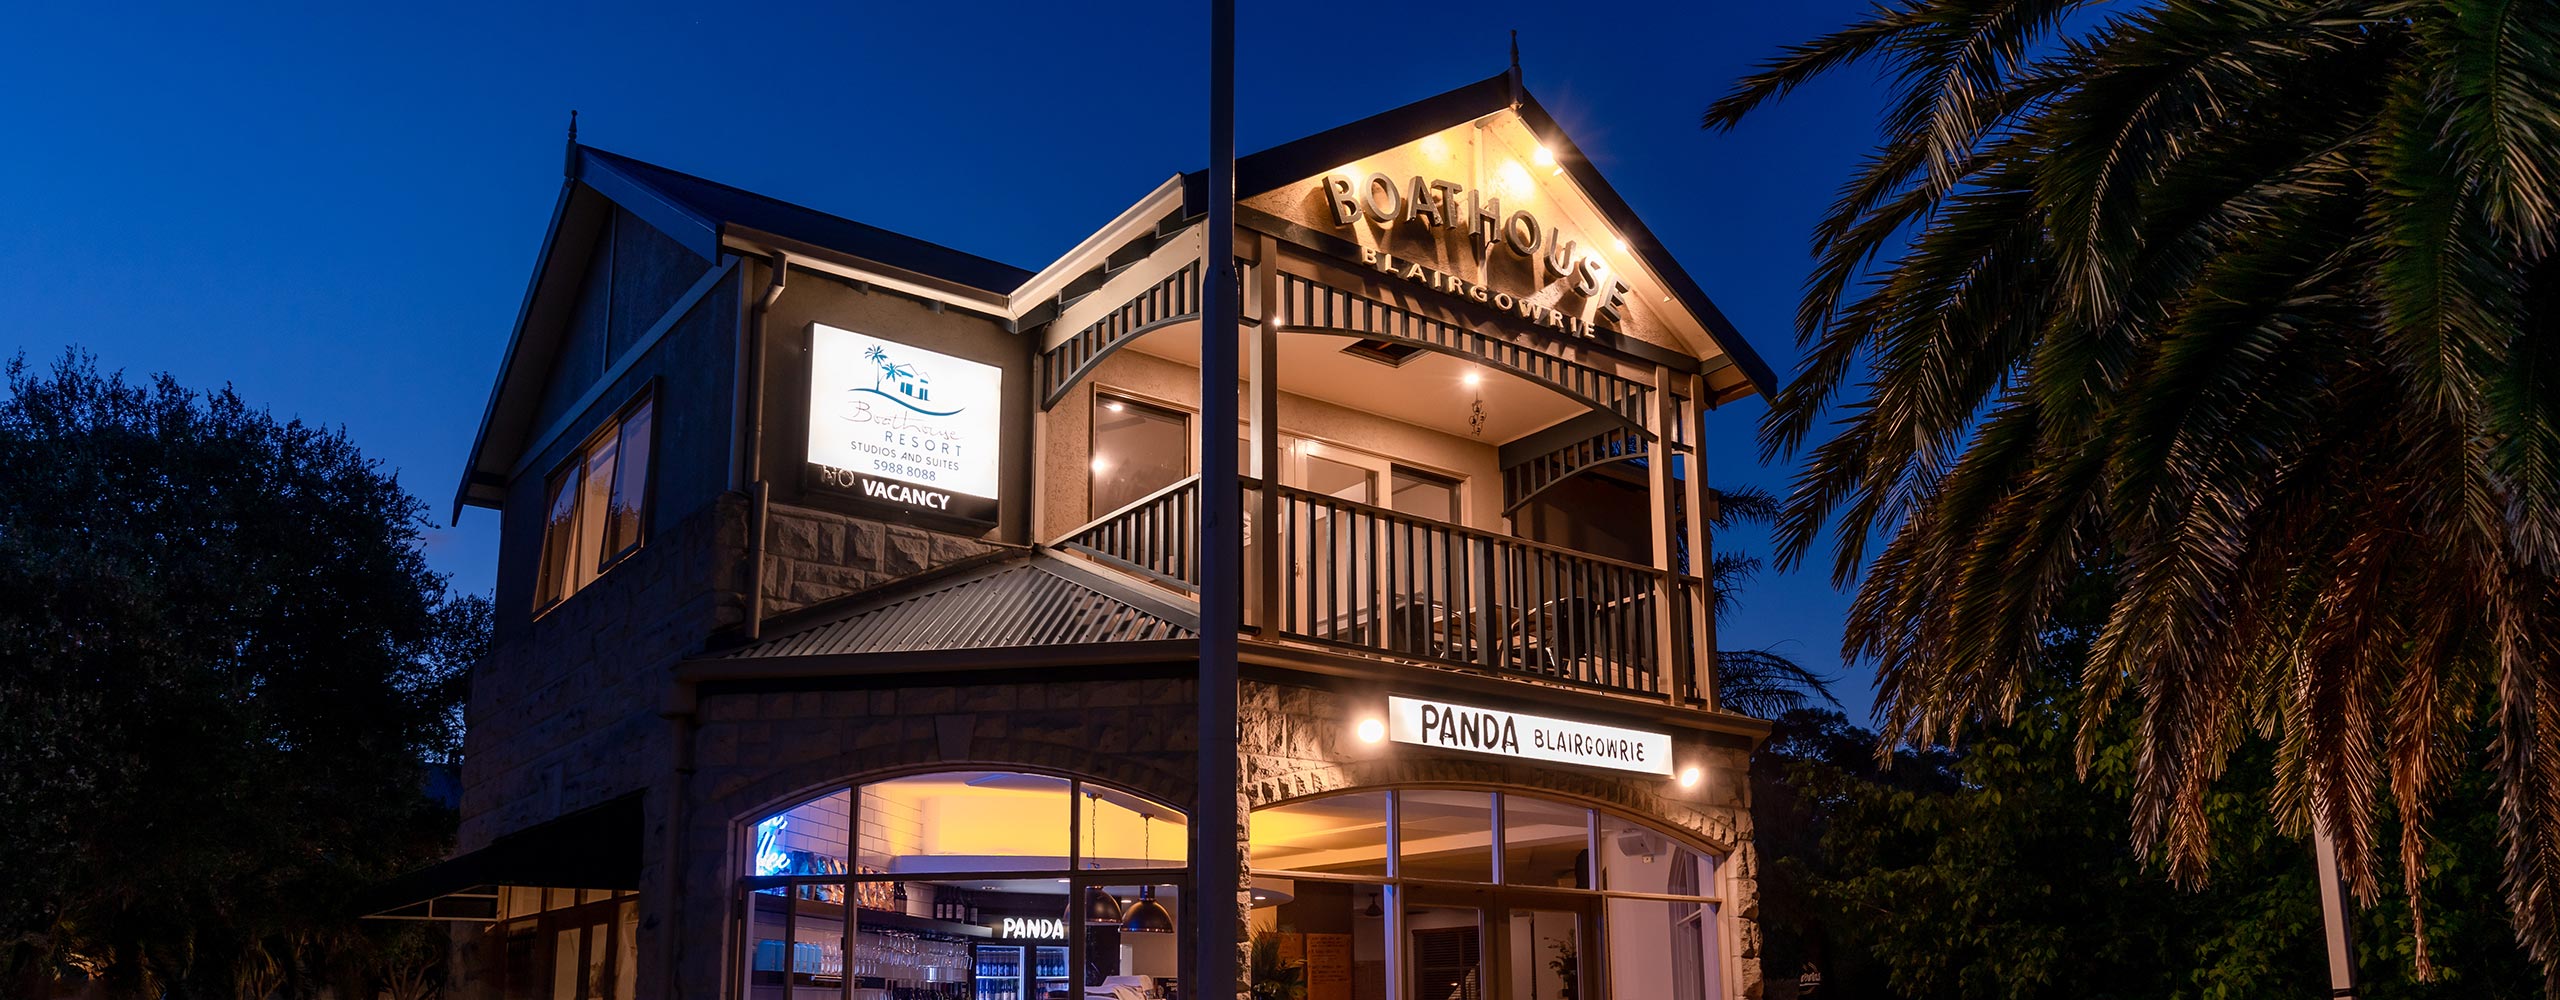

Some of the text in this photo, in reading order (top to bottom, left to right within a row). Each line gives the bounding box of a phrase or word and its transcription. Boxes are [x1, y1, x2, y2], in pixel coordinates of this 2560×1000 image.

[1322, 172, 1630, 323] BOATHOUSE
[1361, 246, 1596, 339] BLAIRGOWRIE
[840, 400, 962, 440] Boathouse
[851, 440, 959, 471] STUDIOS AND SUITES
[884, 430, 961, 457] RESORT
[821, 465, 950, 510] NO VACANCY
[873, 459, 936, 481] 5988 8088
[1421, 704, 1645, 762] PANDA BLAIRGOWRIE
[1002, 917, 1064, 940] PANDA
